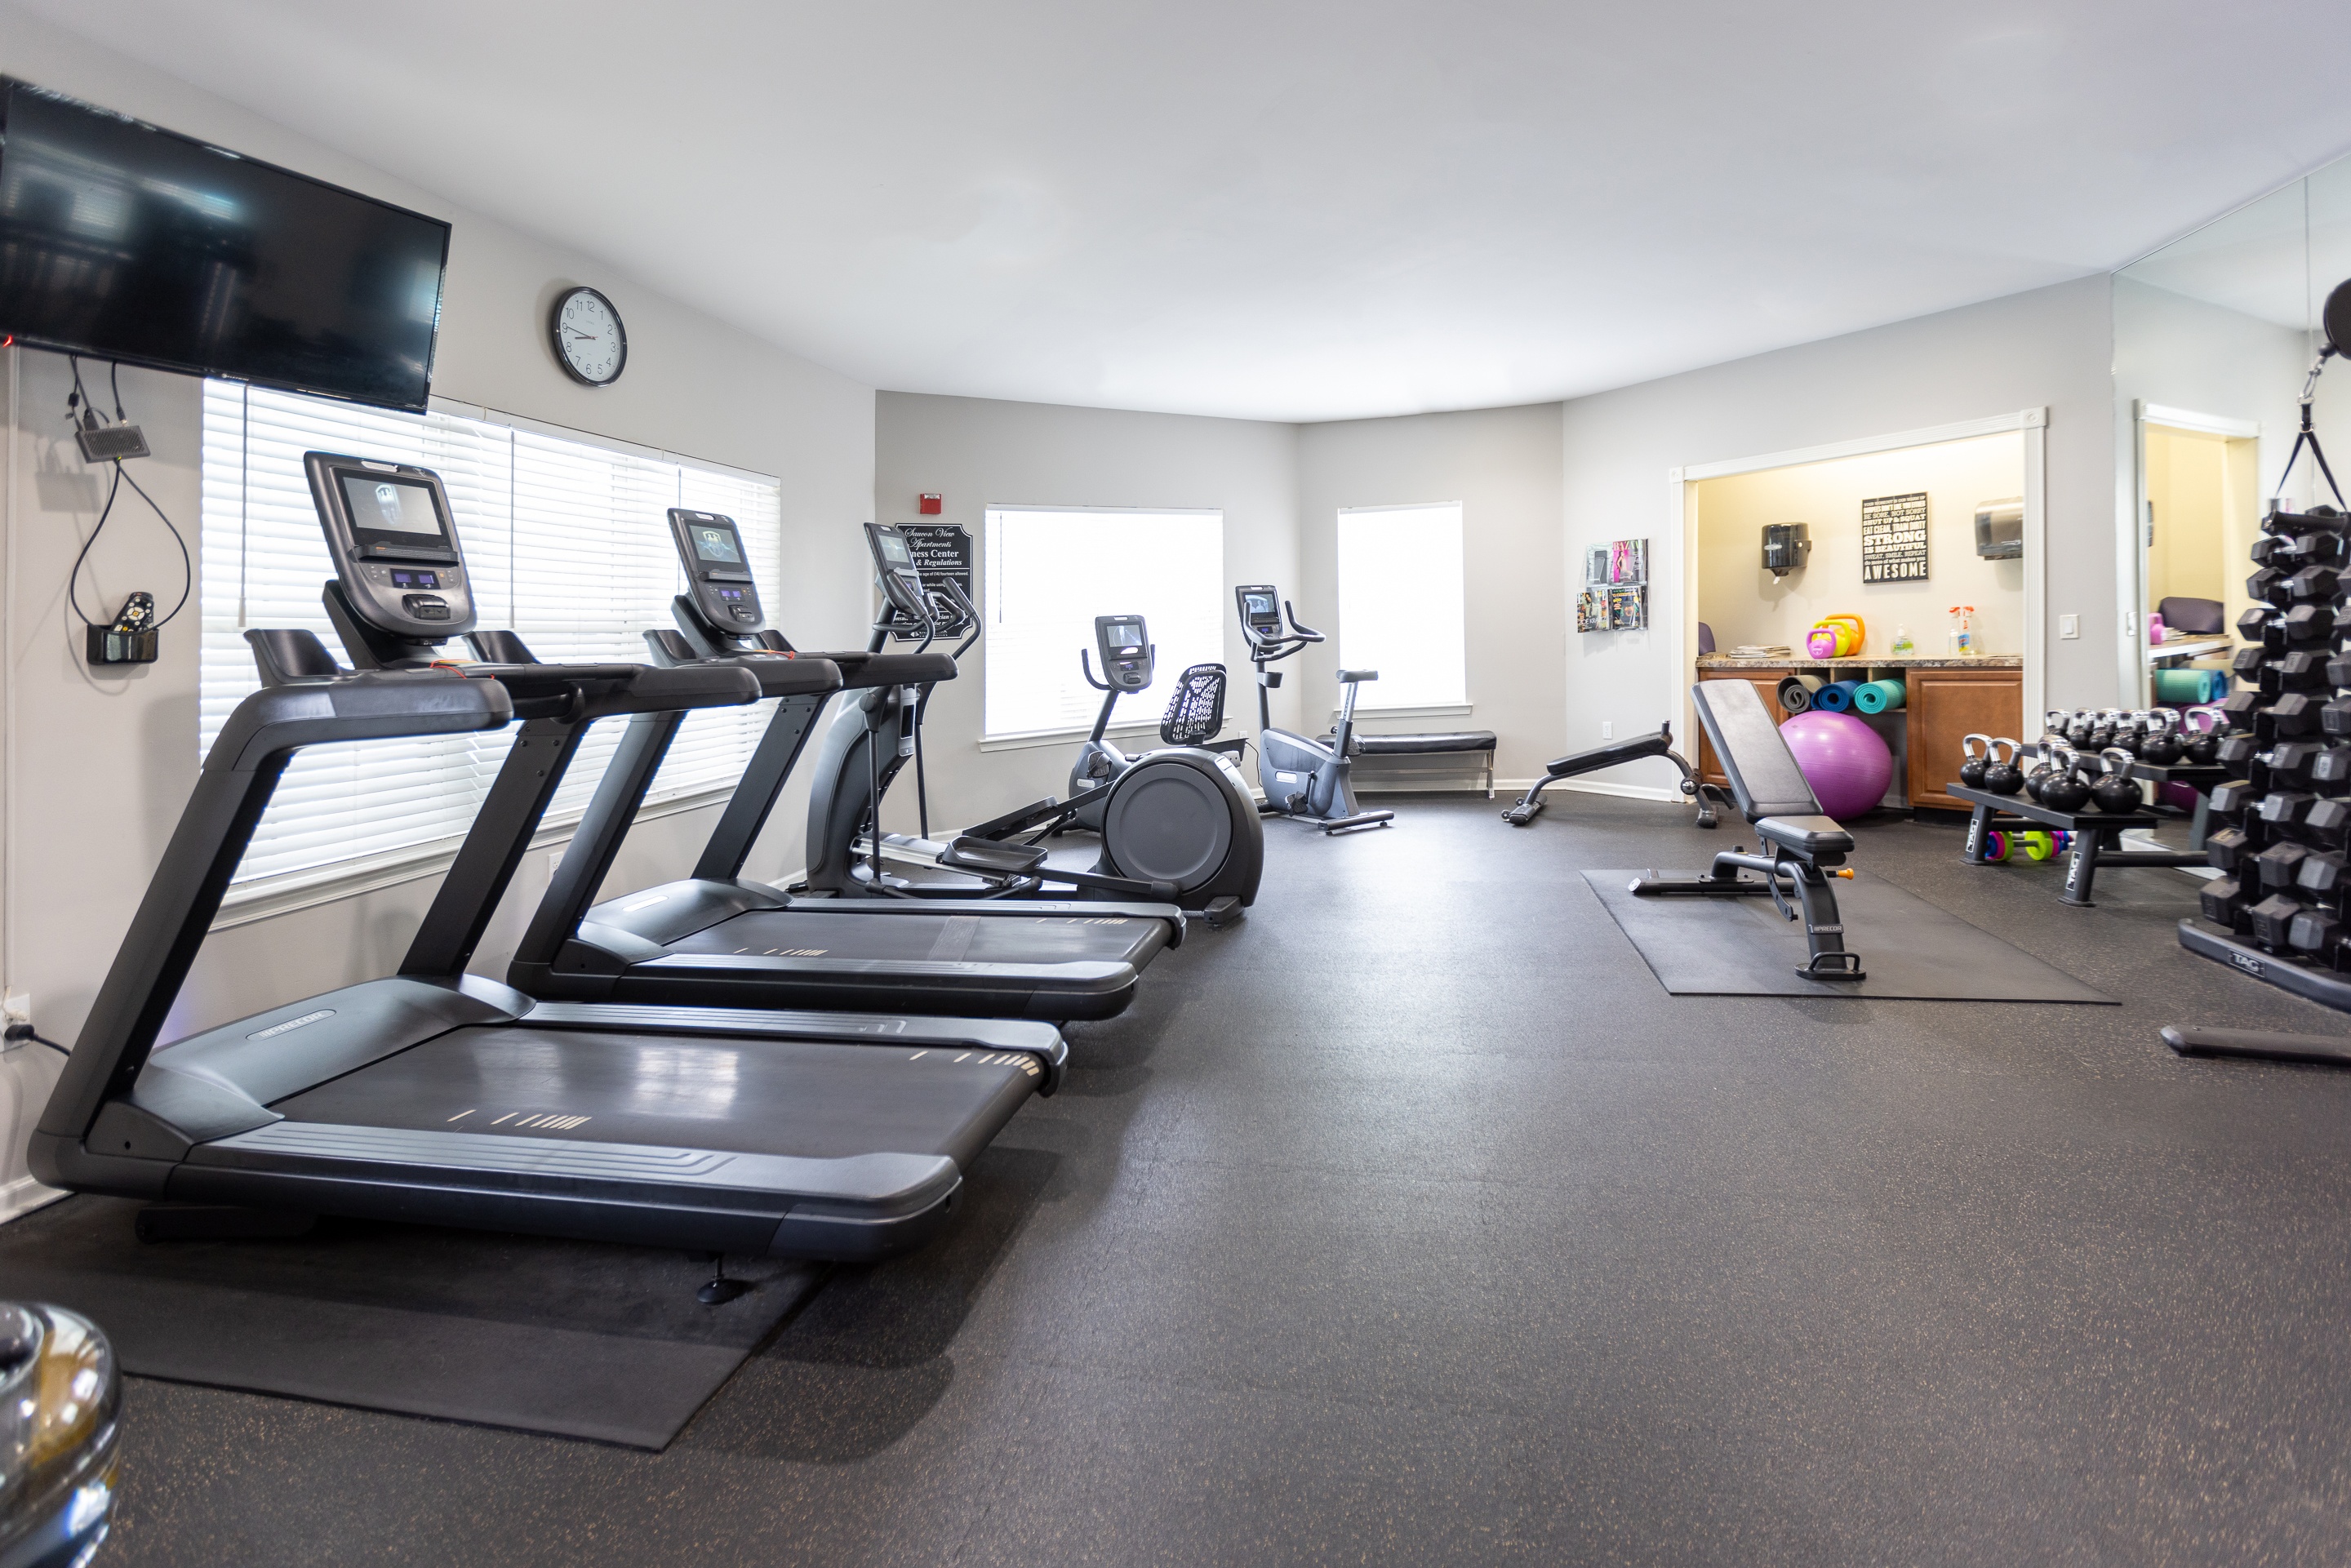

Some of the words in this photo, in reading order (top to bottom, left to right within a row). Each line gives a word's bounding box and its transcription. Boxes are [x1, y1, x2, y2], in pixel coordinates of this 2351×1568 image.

[576, 300, 583, 312] 11
[586, 300, 595, 313] 12
[566, 307, 575, 320] 10
[600, 310, 603, 320] 1
[562, 322, 568, 334] 9
[607, 324, 613, 335] 2
[566, 341, 572, 353] 8
[611, 342, 616, 353] 3
[576, 355, 581, 366] 7
[606, 358, 611, 367] 4
[585, 363, 592, 375] 6
[597, 363, 603, 375] 5
[904, 527, 932, 537] Saucon
[935, 526, 955, 538] View
[1864, 526, 1873, 535] EAT
[909, 537, 952, 550] Apartments
[1864, 530, 1926, 546] STRONG
[931, 549, 959, 557] Center
[1864, 546, 1874, 554] IS
[1874, 541, 1927, 553] BEAUTIFUL
[923, 559, 962, 567] Regulations
[1864, 562, 1927, 580] AWESOME
[266, 1012, 325, 1036] PRECOR
